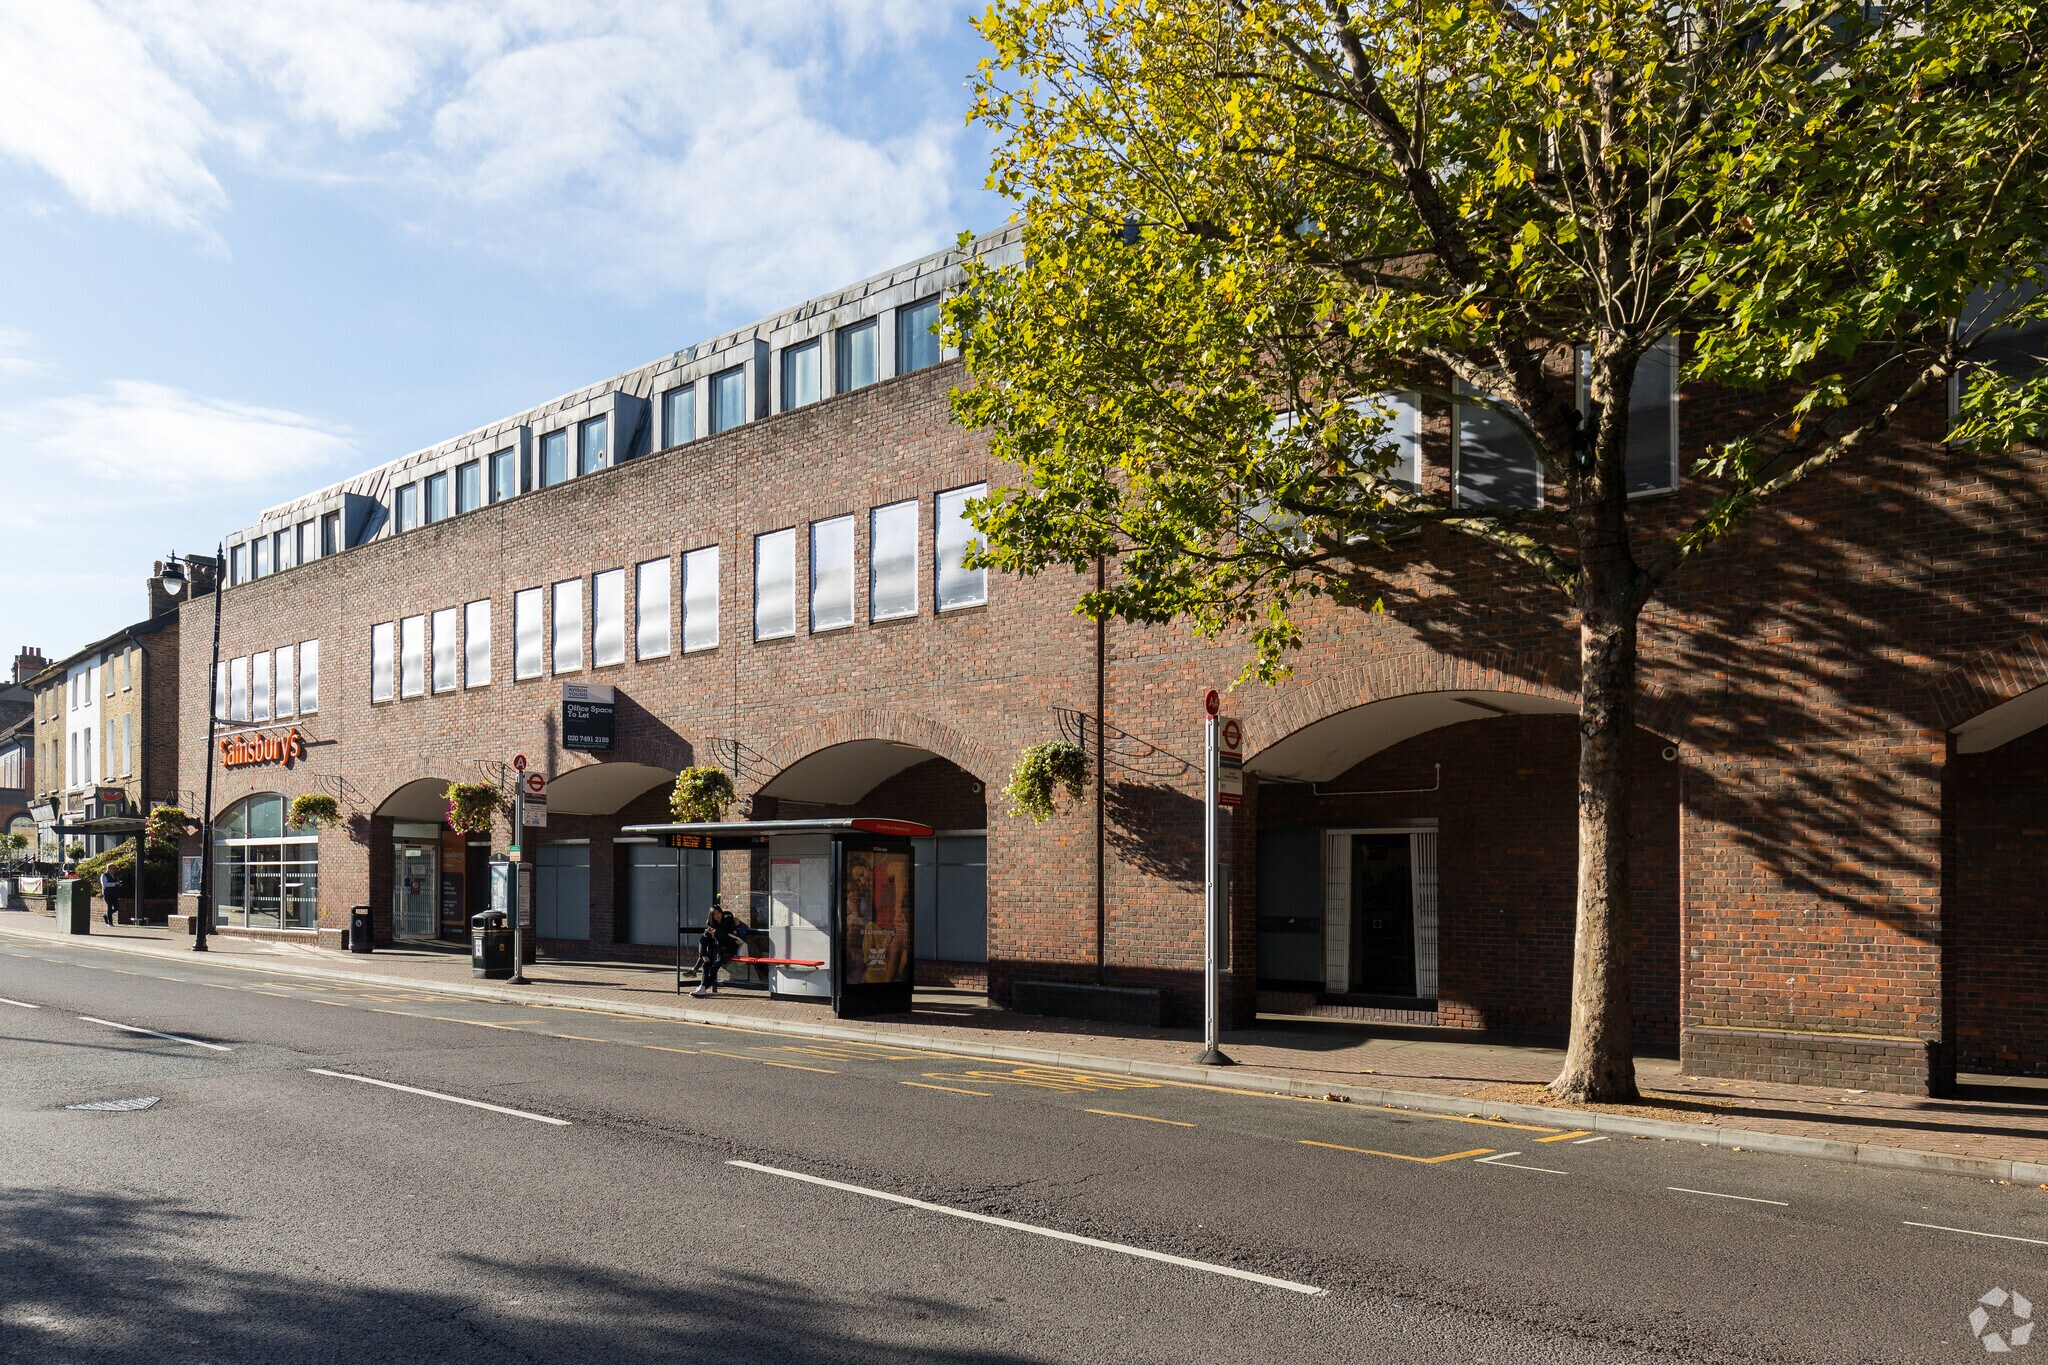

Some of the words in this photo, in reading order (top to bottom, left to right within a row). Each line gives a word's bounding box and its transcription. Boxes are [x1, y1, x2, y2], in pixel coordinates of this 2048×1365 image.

[591, 706, 612, 714] Space
[219, 727, 301, 767] Sainsbury's
[516, 756, 525, 769] A
